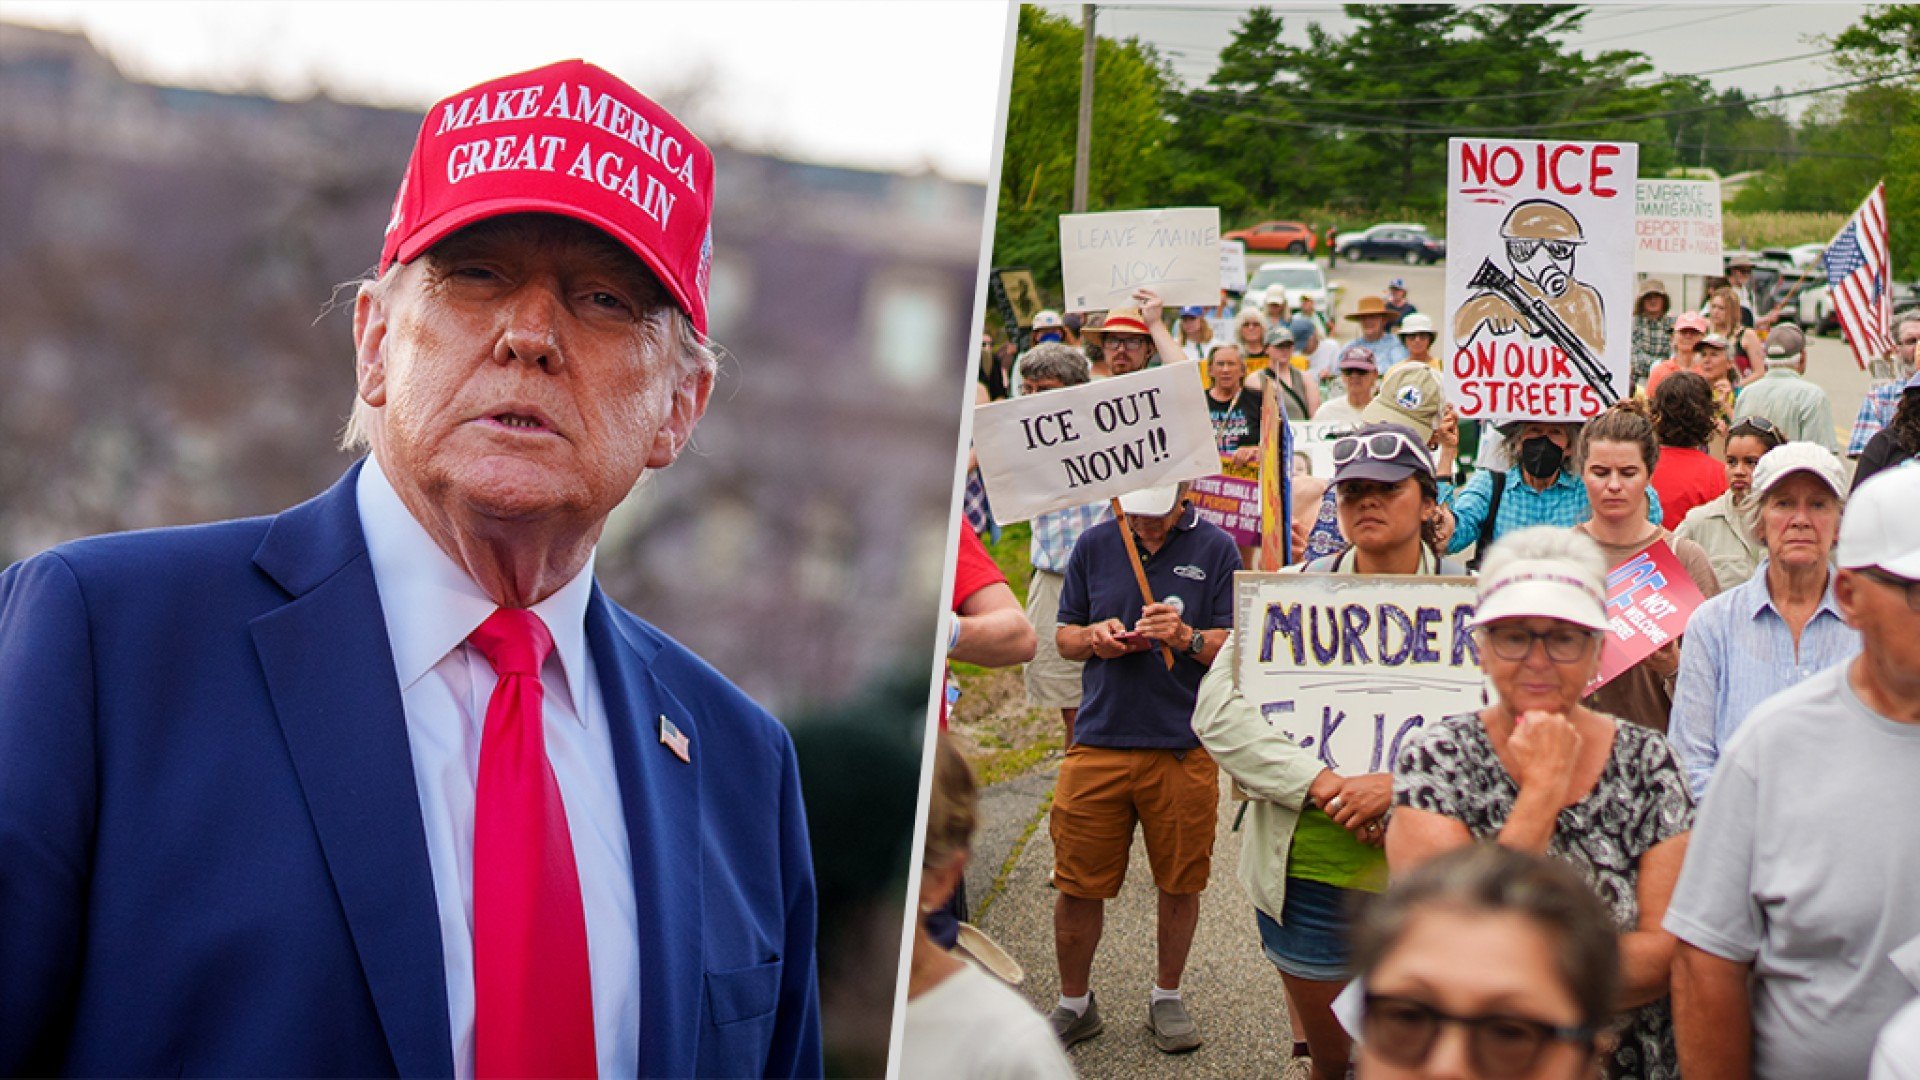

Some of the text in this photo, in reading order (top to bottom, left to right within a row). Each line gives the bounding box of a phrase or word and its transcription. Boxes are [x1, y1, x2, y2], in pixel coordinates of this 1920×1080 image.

[435, 81, 698, 194] MAKE AMERICA
[447, 134, 678, 232] GREAT AGAIN
[1459, 142, 1621, 198] NO ICE
[1077, 226, 1217, 250] LEAVE MAINE
[1110, 256, 1179, 290] NOW
[1453, 340, 1573, 380] ON OUR
[1020, 408, 1080, 450] ICE
[1093, 387, 1161, 434] OUT
[1459, 379, 1602, 418] STREETS
[1061, 426, 1169, 488] NOW!!
[1259, 601, 1481, 666] MURDER
[1639, 591, 1679, 621] NOT
